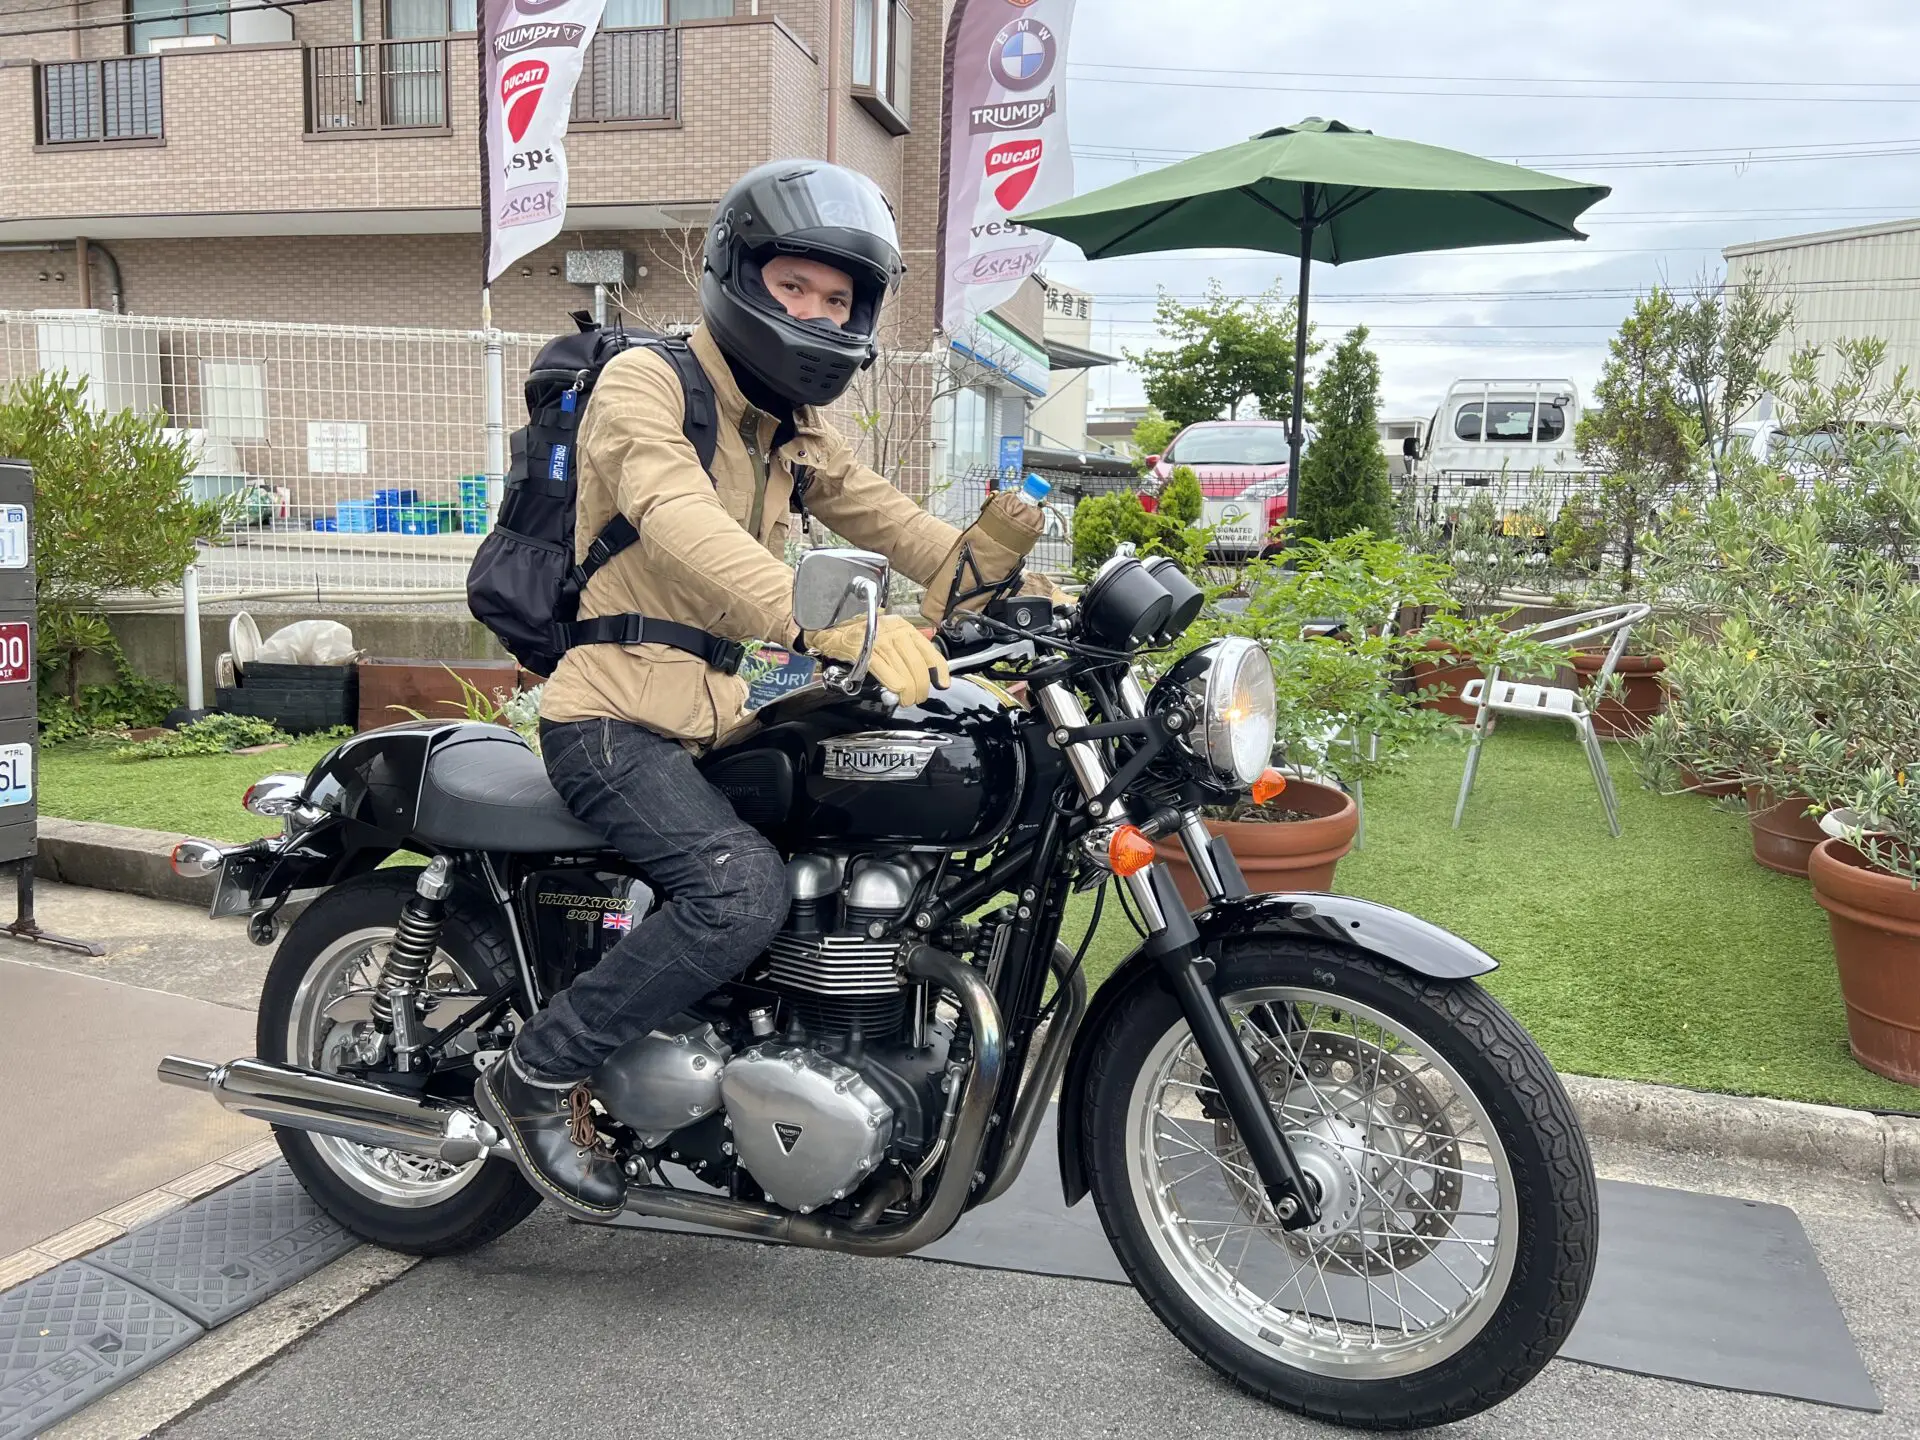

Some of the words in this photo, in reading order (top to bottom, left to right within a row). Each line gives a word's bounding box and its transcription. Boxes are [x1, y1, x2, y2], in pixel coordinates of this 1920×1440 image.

[494, 25, 560, 54] TRIUMPH
[503, 67, 545, 94] DUCATI
[990, 144, 1041, 166] DUCATI
[832, 749, 915, 774] TRIUMPH
[539, 892, 636, 910] THRUXTON
[566, 909, 600, 921] 900
